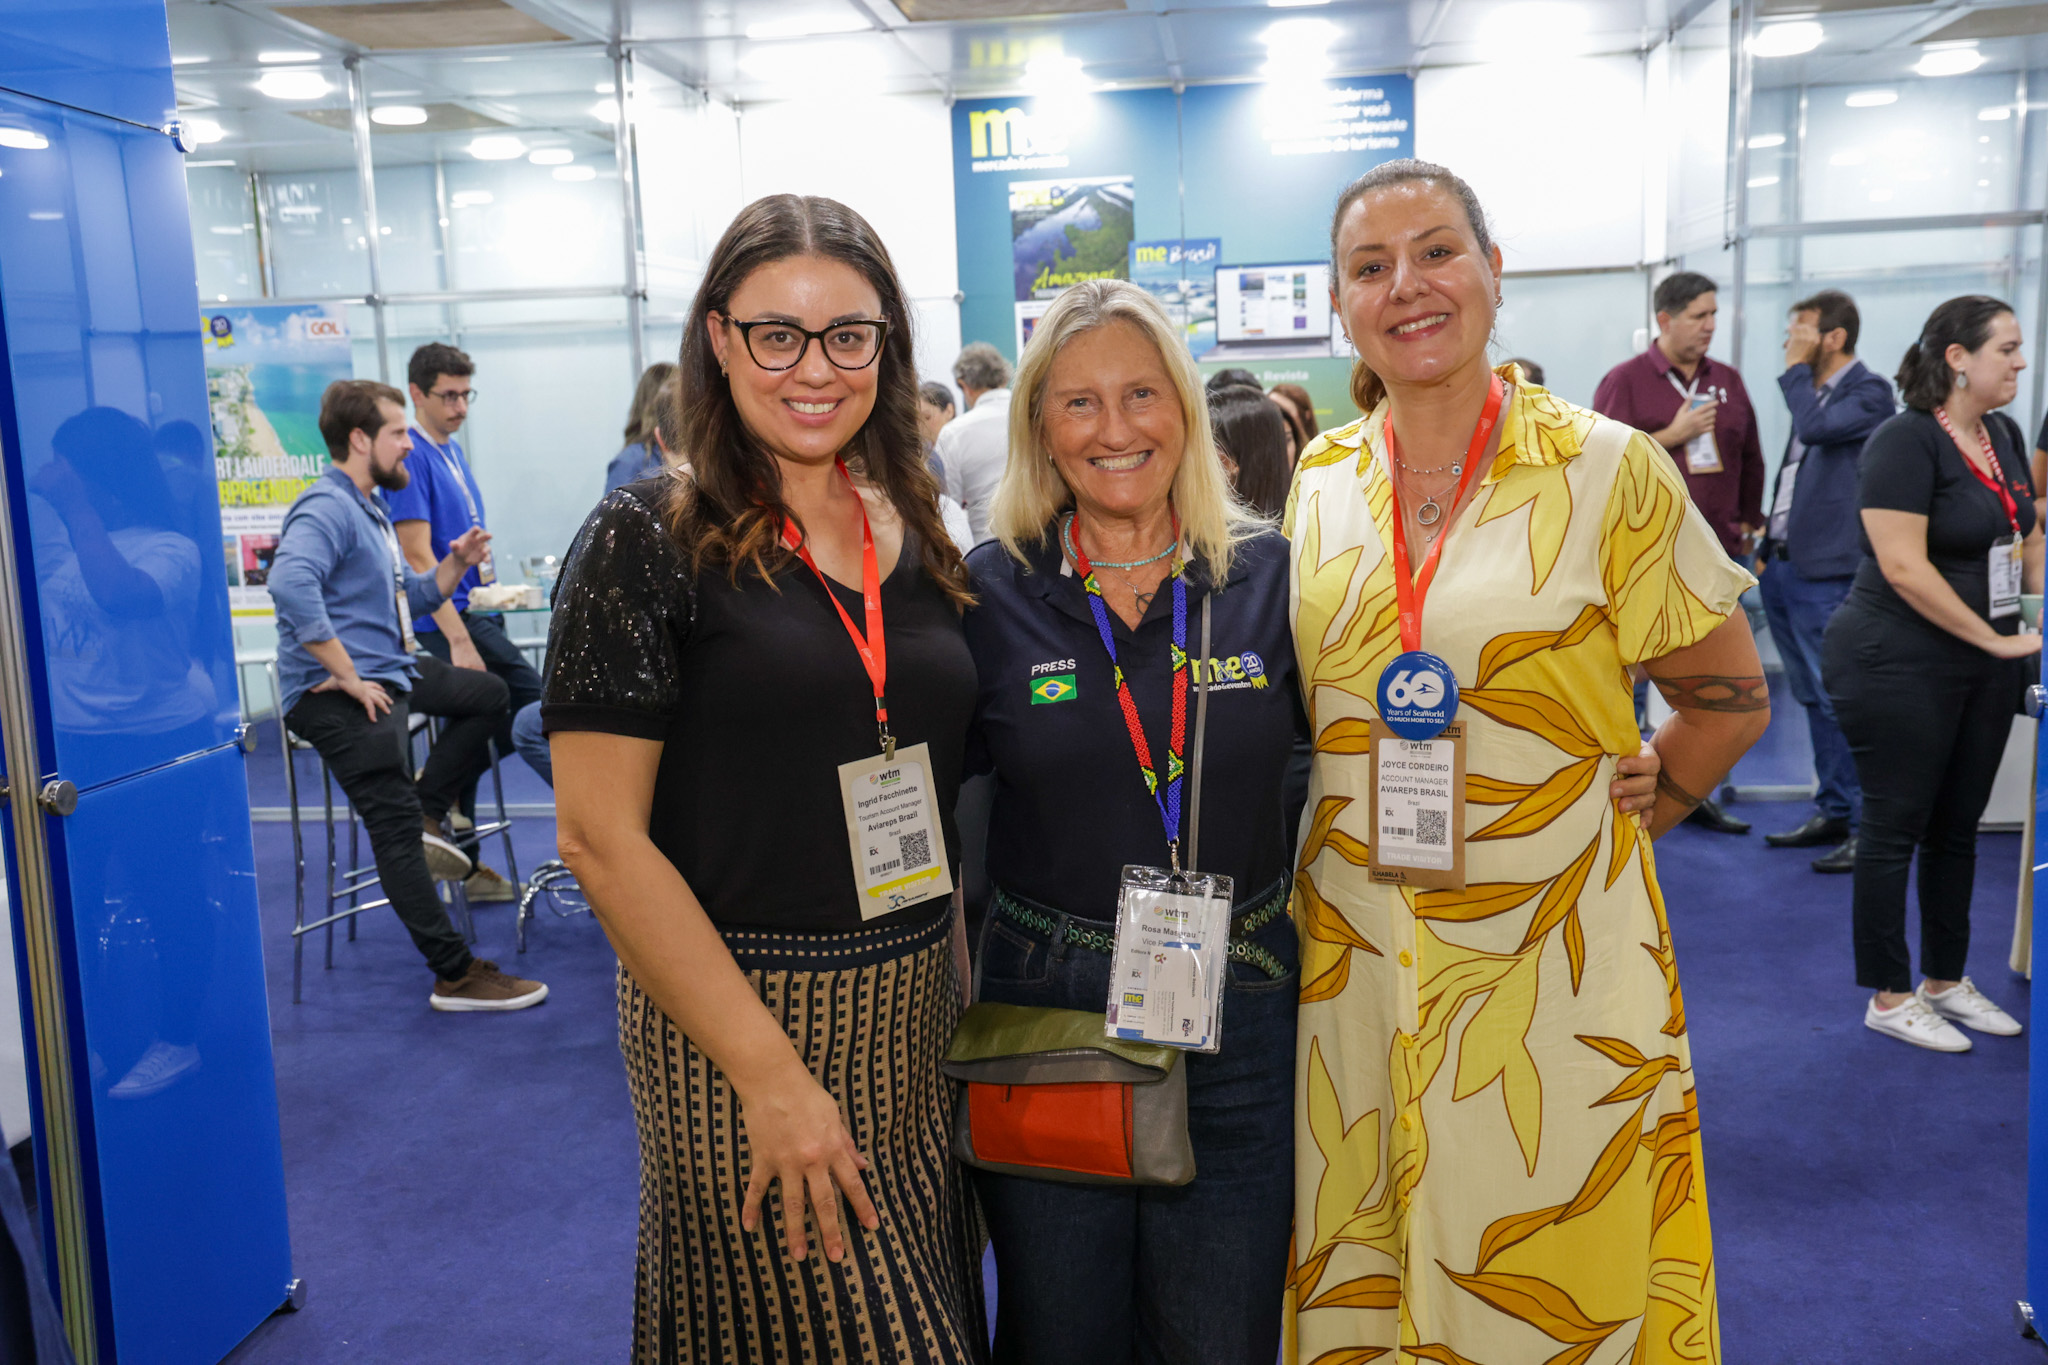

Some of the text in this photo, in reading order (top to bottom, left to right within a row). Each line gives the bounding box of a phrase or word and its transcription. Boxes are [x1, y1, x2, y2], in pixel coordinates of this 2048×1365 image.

[310, 322, 340, 335] GOL
[216, 457, 232, 479] RT
[1031, 658, 1076, 676] PRESS
[1386, 707, 1445, 718] Years of SeaWorld
[1410, 741, 1433, 751] wtm
[1380, 760, 1449, 772] JOYCE CORDEIRO
[879, 769, 901, 781] wtm
[1381, 774, 1449, 786] ACCOUNT MANAGER
[1380, 785, 1449, 798] AVIAREPS BRASIL
[857, 796, 879, 809] Ingrid
[867, 810, 918, 833] Aviareps Brazil
[1386, 852, 1411, 861] TRADE
[1165, 908, 1189, 919] wtm
[1141, 924, 1162, 934] Rosa
[1142, 937, 1157, 947] Vice
